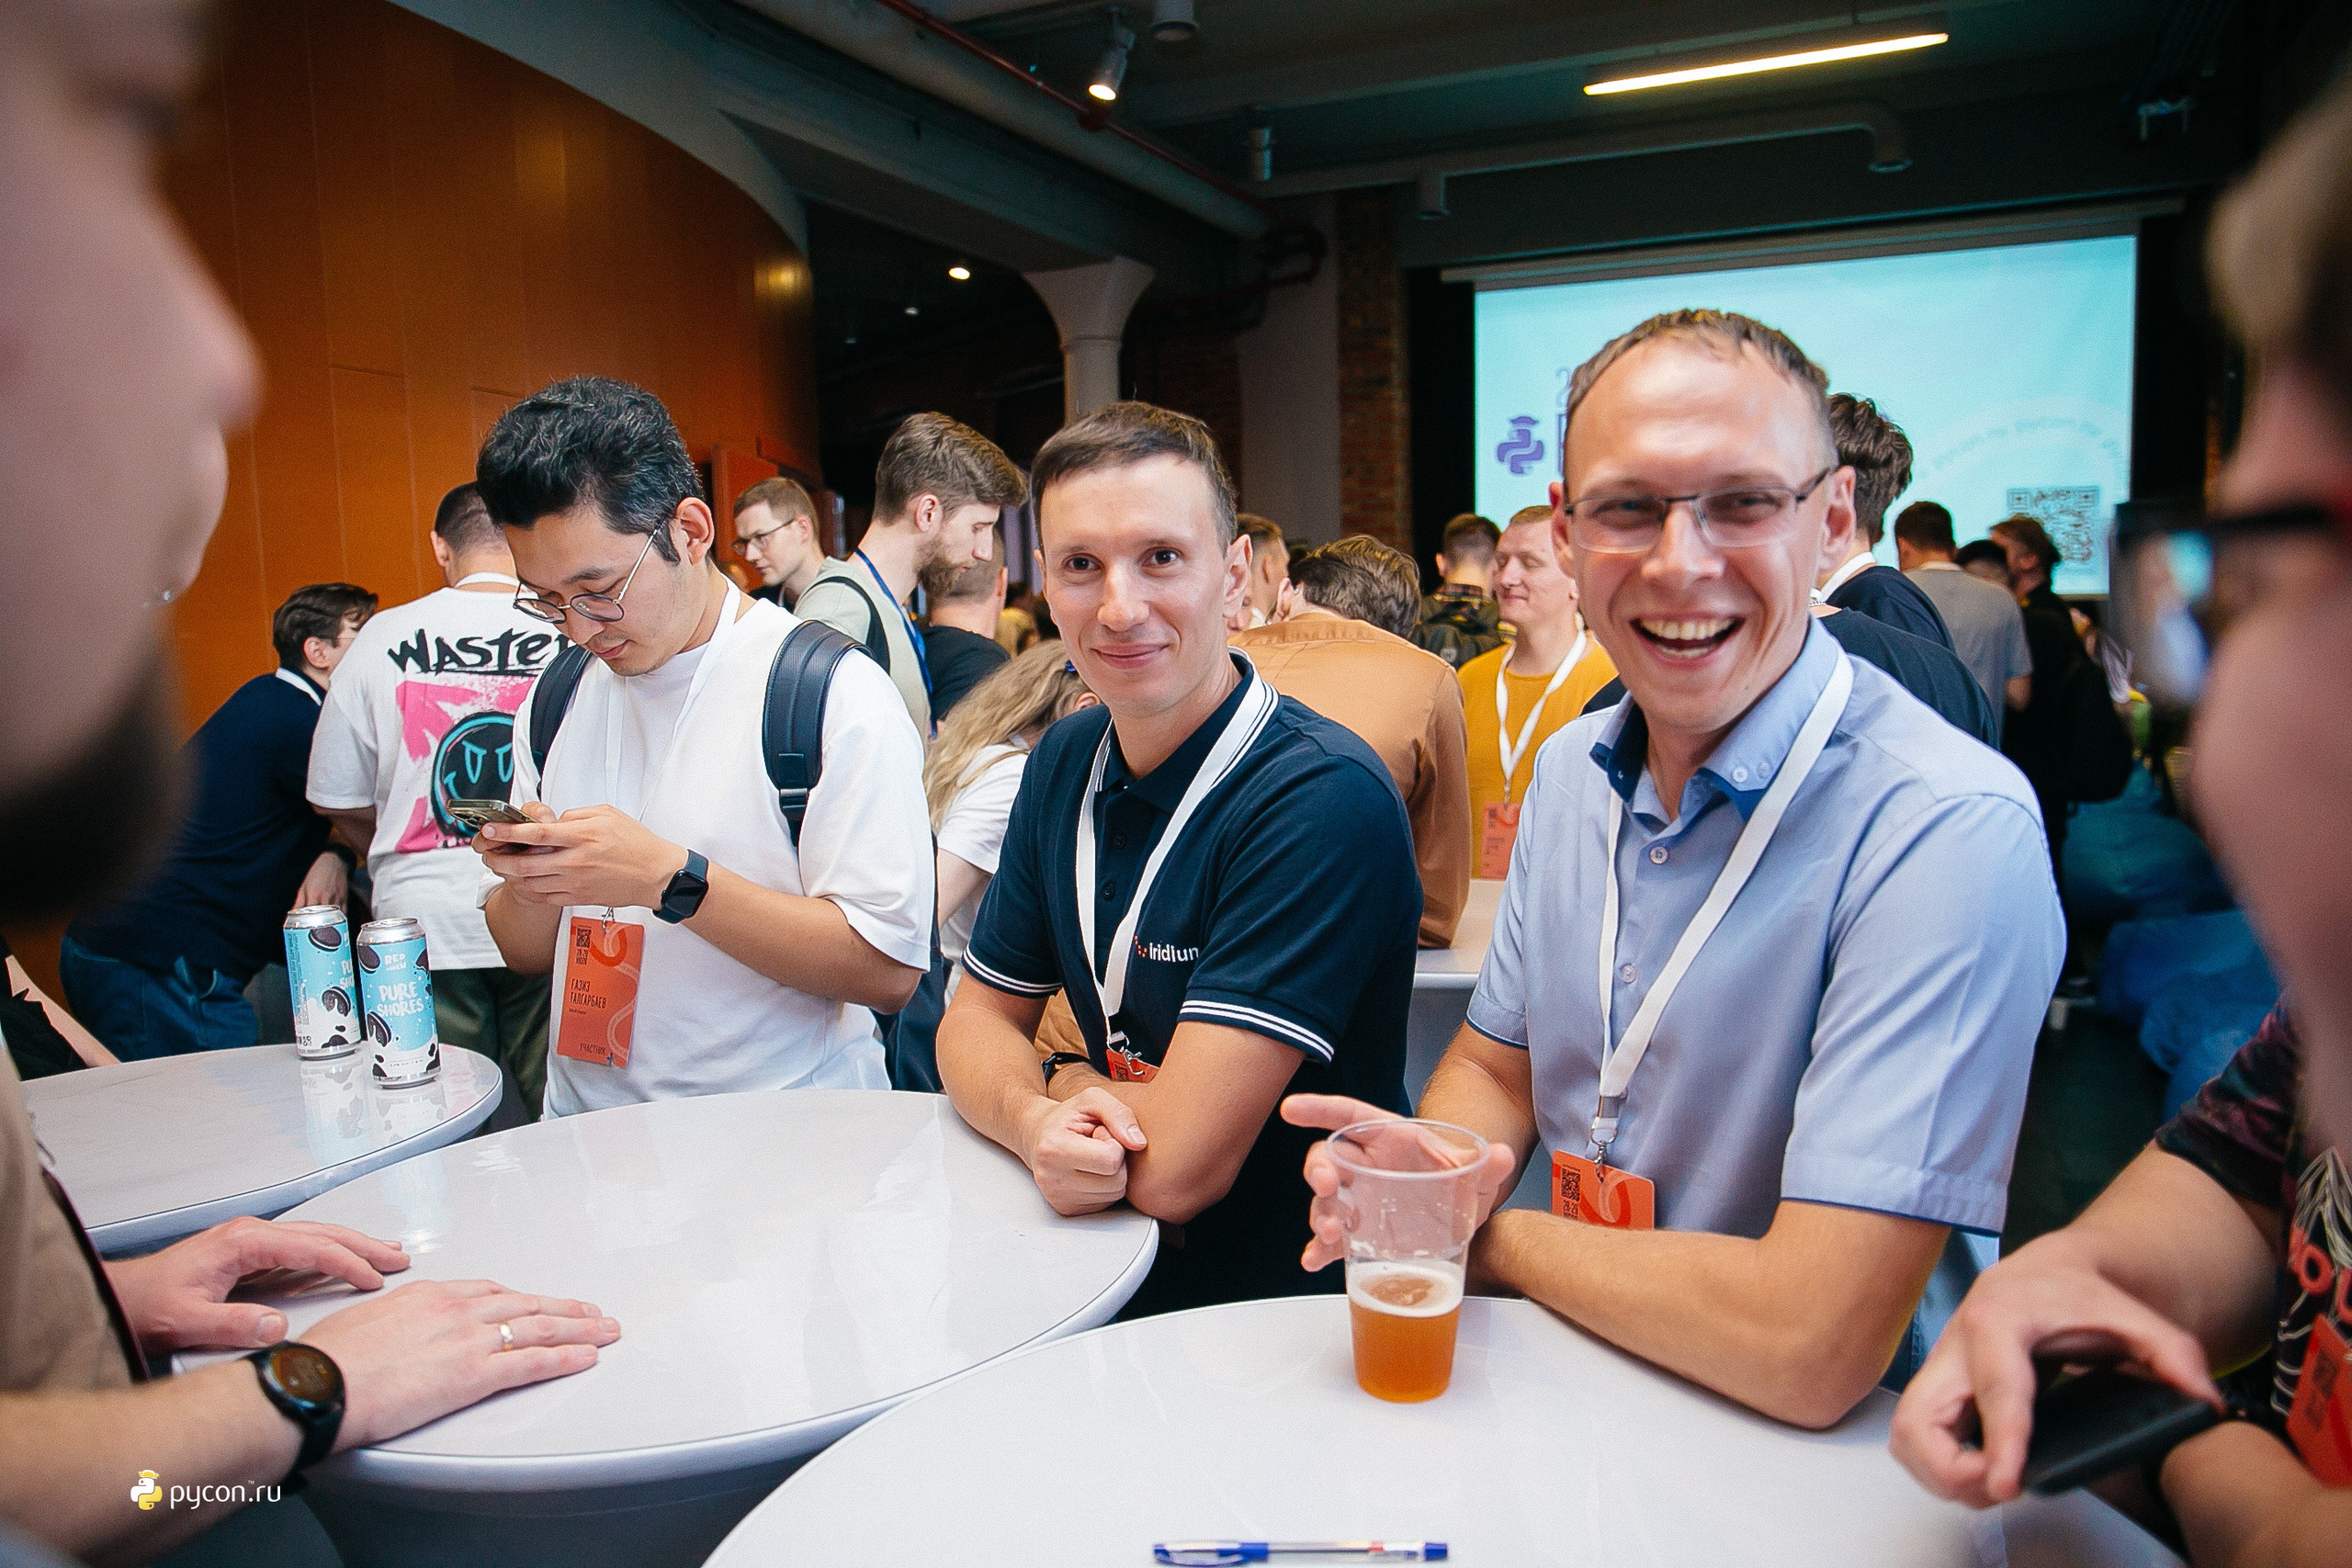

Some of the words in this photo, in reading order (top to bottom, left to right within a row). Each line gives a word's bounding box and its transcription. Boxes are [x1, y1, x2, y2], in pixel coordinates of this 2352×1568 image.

[379, 981, 418, 1002] PURE
[571, 978, 591, 993] ГАЗИЗ
[377, 998, 424, 1017] SHORES
[570, 992, 607, 1010] ТАЛГАРБАЕВ
[579, 1043, 606, 1055] УЧАСТНИК
